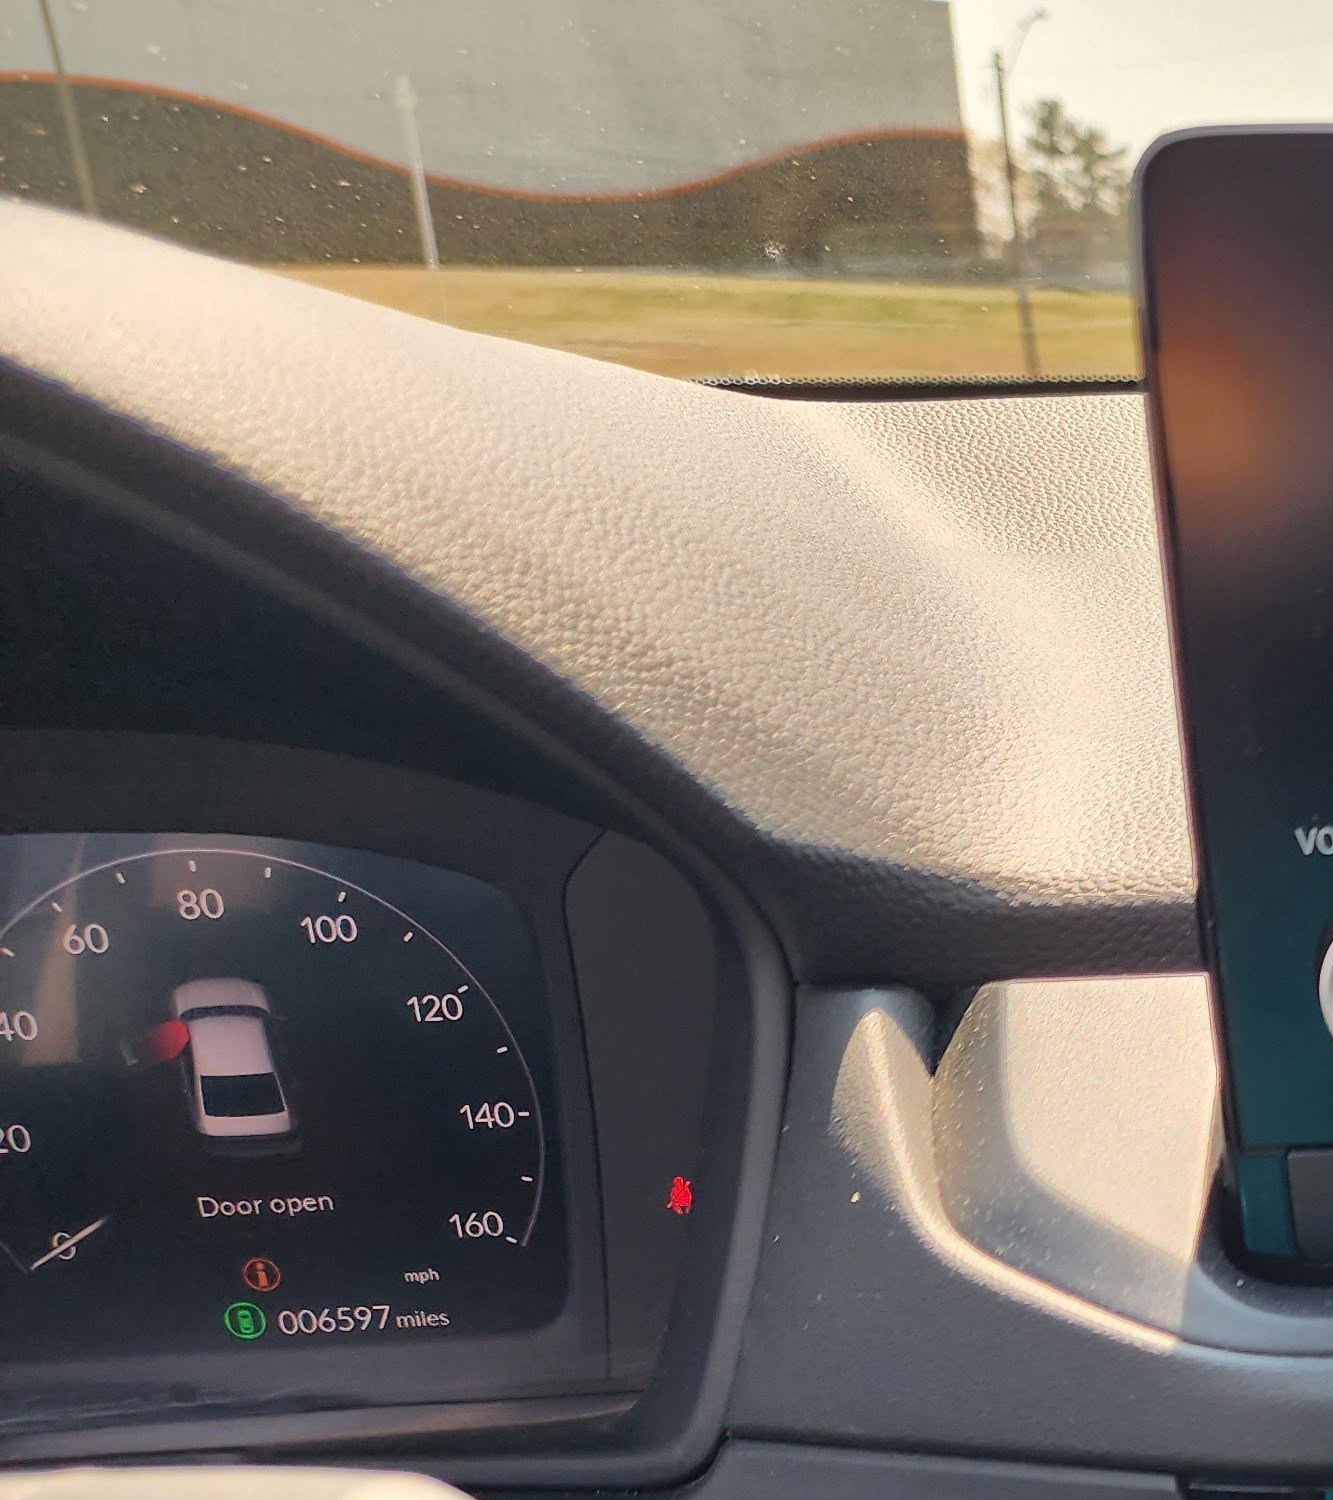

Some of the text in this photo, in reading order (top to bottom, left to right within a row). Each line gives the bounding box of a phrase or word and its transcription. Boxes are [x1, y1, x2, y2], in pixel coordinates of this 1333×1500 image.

[177, 889, 224, 920] 80
[63, 923, 109, 955] 60
[300, 914, 358, 944] 100
[406, 992, 463, 1024] 120
[459, 1102, 516, 1130] 140
[197, 1191, 334, 1218] Door open
[448, 1210, 504, 1240] 160
[403, 1266, 440, 1284] mph
[276, 1304, 451, 1336] 006597 miles
